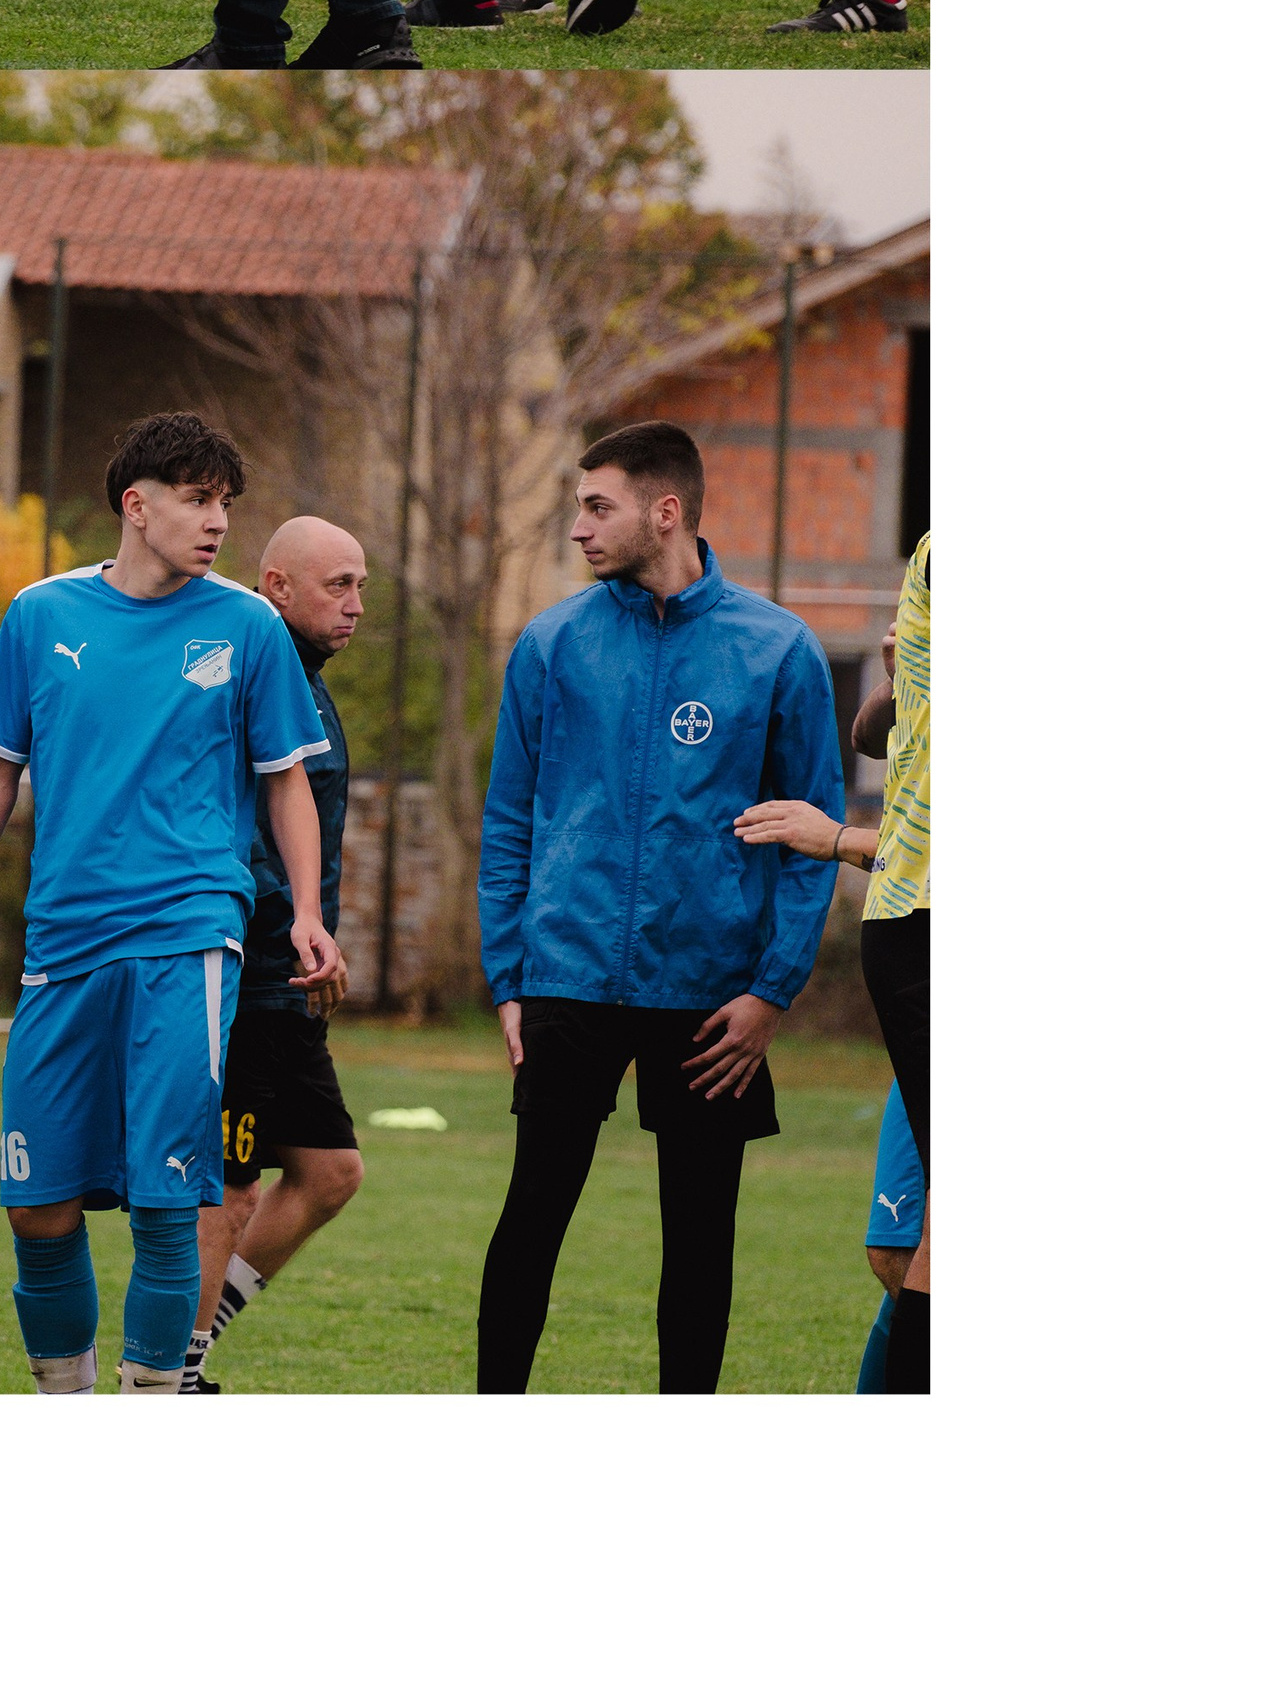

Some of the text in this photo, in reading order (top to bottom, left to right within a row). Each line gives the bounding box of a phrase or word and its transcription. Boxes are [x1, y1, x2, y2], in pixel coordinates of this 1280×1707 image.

[674, 718, 710, 728] BAYER
[686, 704, 697, 741] BAYER
[0, 1130, 31, 1182] 16
[221, 1109, 256, 1164] 16
